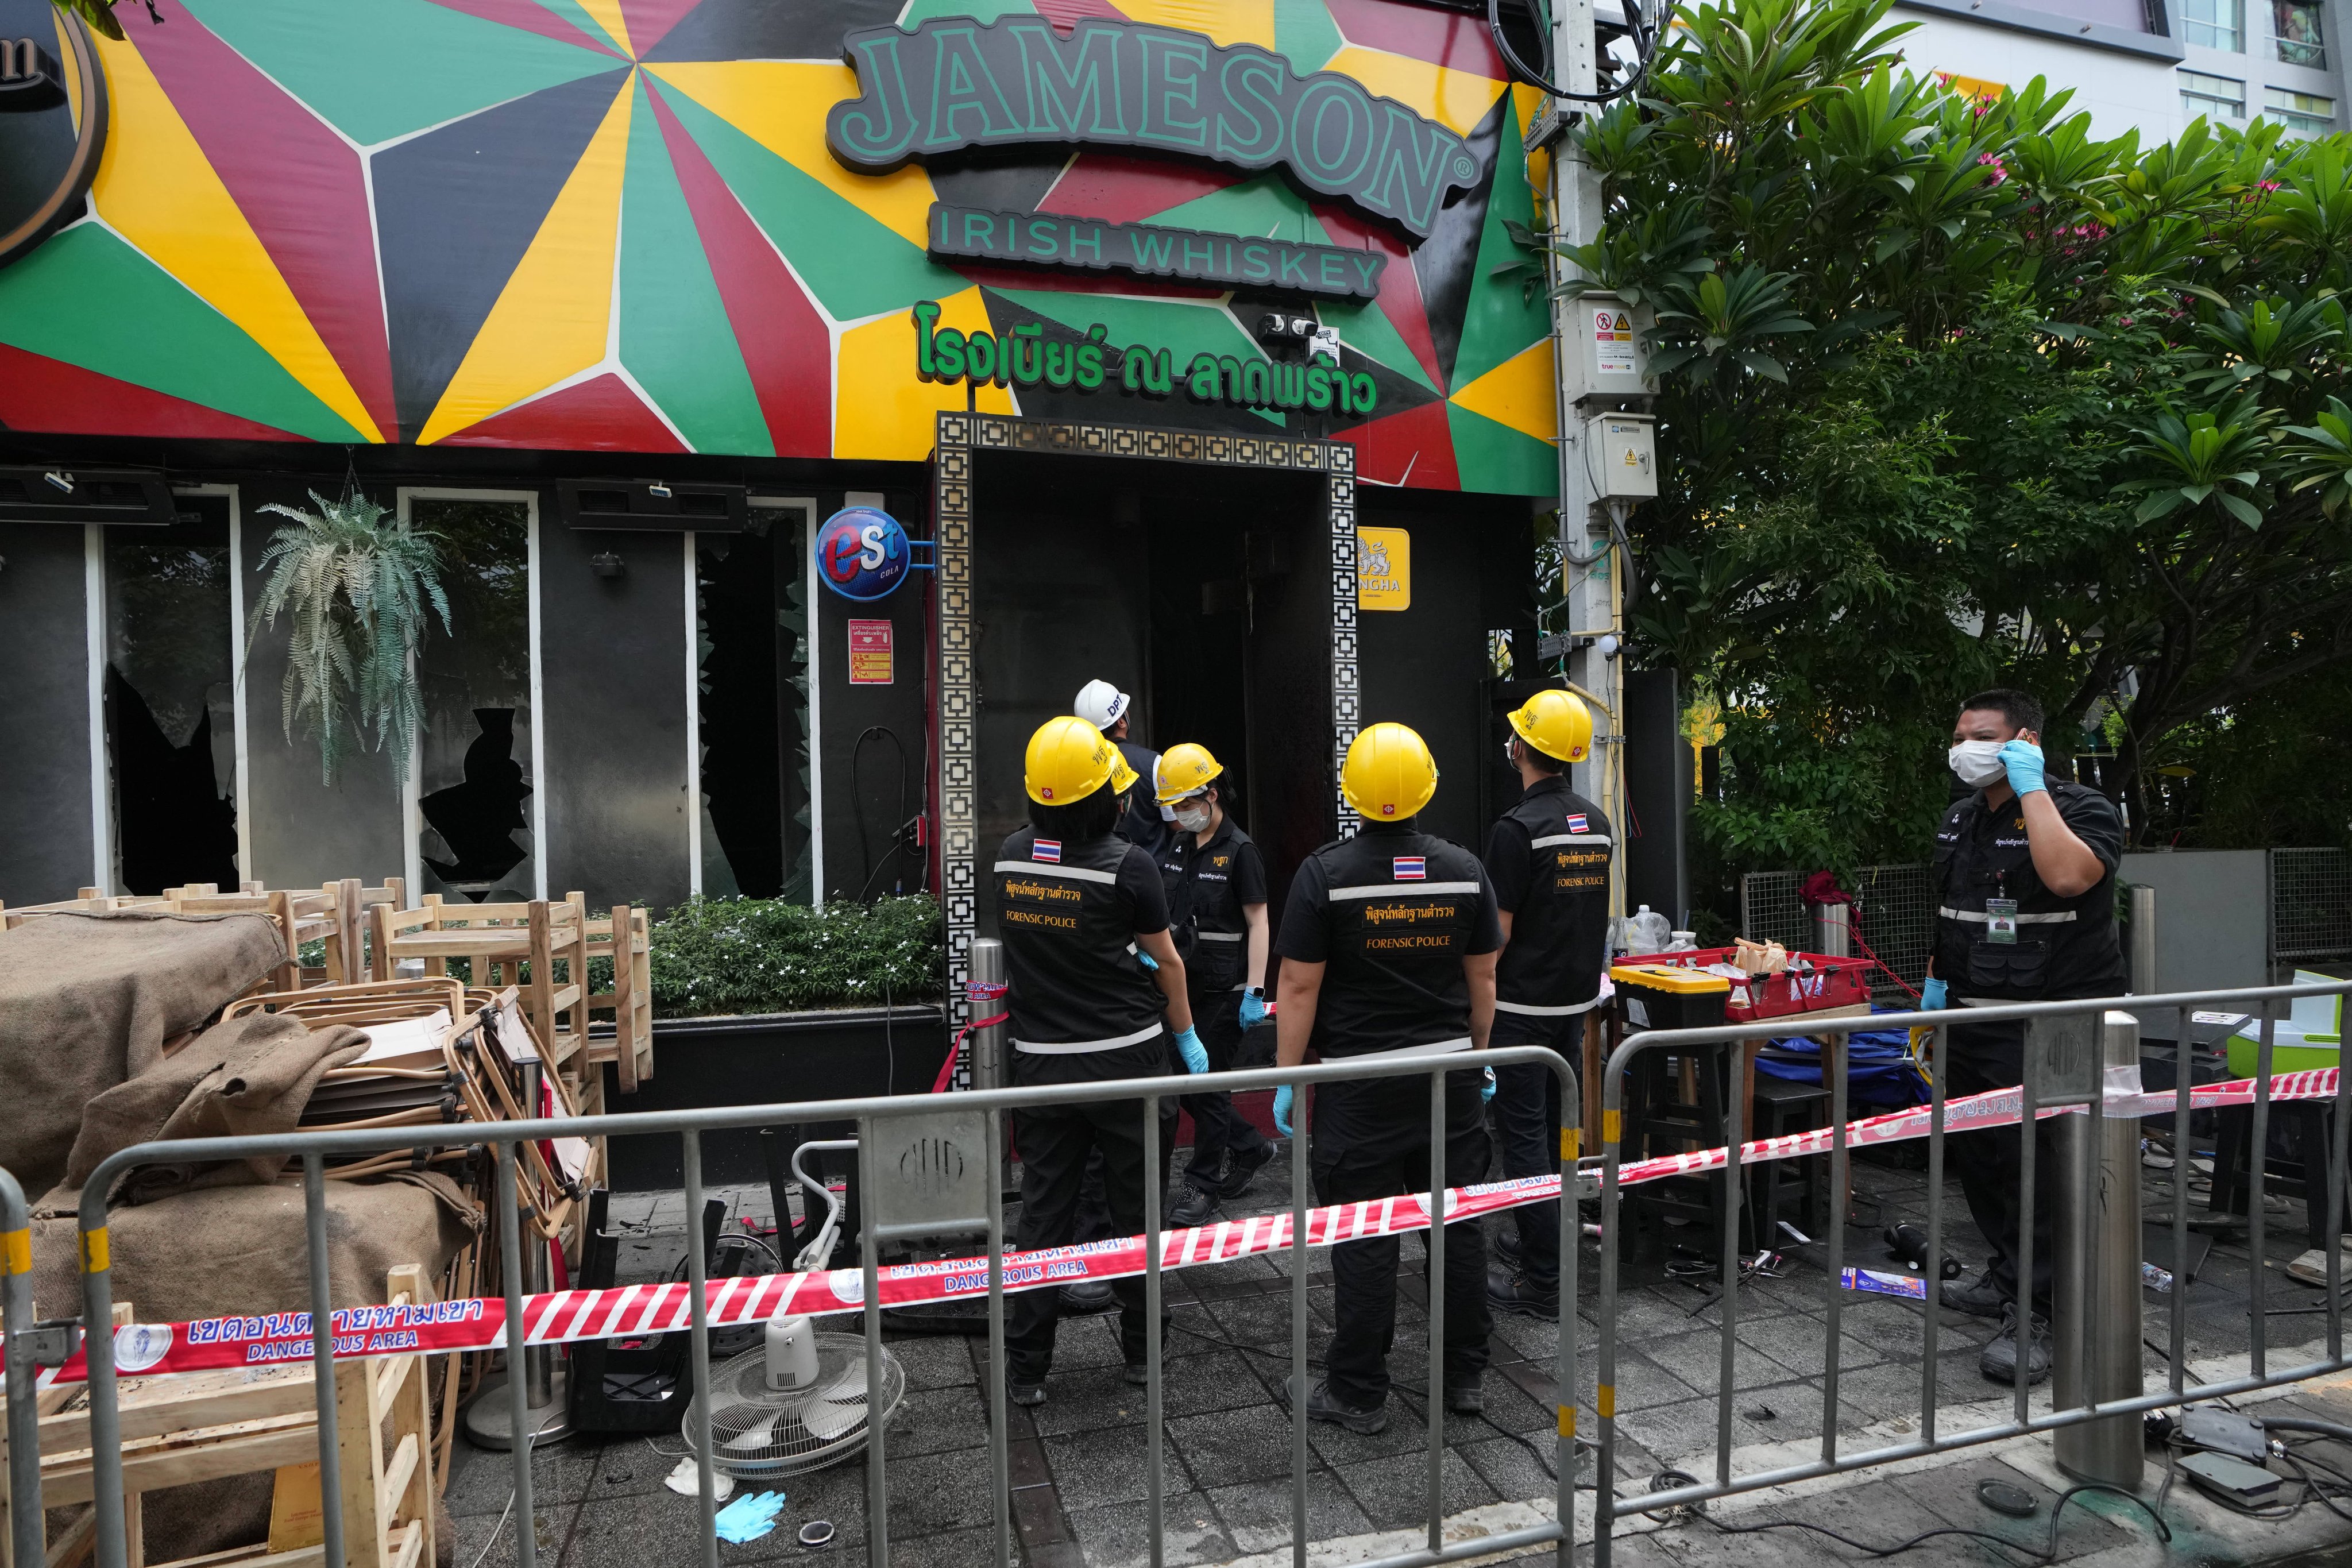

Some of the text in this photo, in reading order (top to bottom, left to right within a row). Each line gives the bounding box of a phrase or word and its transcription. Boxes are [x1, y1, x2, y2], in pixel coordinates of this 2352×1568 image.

[840, 25, 1459, 230] JAMESON
[940, 211, 1377, 291] IRISH WHISKEY
[916, 303, 1378, 414] โรงเบียร์ ณ ลาดพร้าว
[826, 524, 898, 584] est
[880, 565, 899, 579] COLA
[1358, 578, 1400, 591] NGHA
[1107, 694, 1122, 717] DPT
[1006, 879, 1081, 901] พิสูจน์หลักฐานตำรวจ
[1557, 876, 1605, 887] FORENSIC POLICE
[1006, 910, 1076, 928] FORENSIC POLICE
[1365, 903, 1454, 925] พิสูจน์หลักฐานตำรวจ
[1366, 936, 1451, 949] FORENSIC POLICE
[944, 1259, 1089, 1293] DANGROUS AREA
[246, 1330, 419, 1362] DANGEOUS AREA
